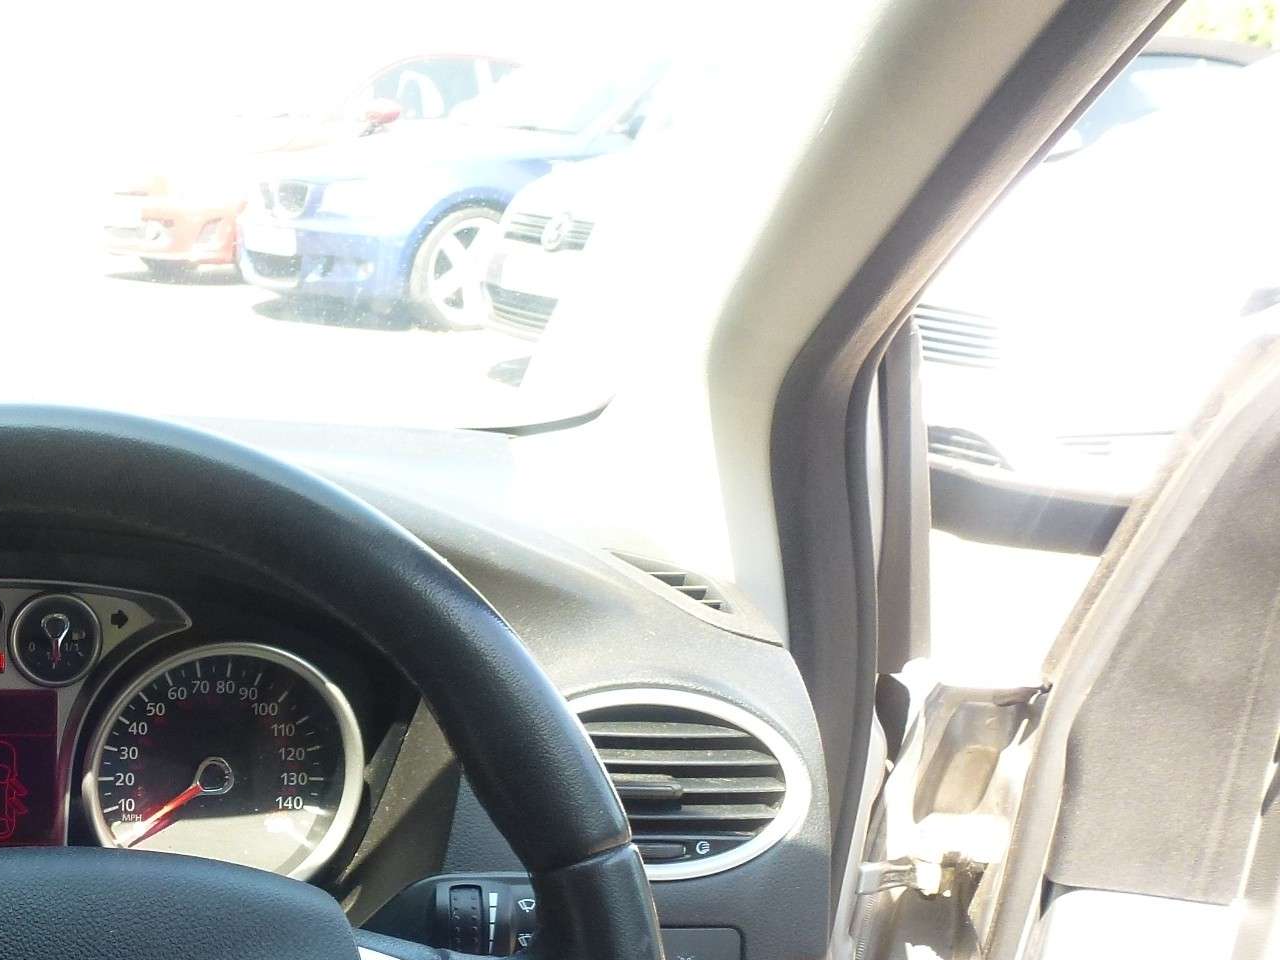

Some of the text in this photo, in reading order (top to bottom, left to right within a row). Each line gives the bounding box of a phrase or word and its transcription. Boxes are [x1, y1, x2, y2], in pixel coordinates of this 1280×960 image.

[167, 687, 187, 700] 60
[191, 680, 210, 694] 70
[215, 680, 235, 694] 80
[239, 687, 258, 700] 90
[146, 702, 166, 716] 50
[251, 702, 279, 716] 100
[128, 722, 148, 735] 40
[271, 723, 296, 737] 110
[119, 746, 139, 760] 30
[278, 747, 305, 761] 120
[115, 772, 135, 786] 20
[280, 772, 308, 786] 130
[117, 798, 135, 812] 10
[275, 796, 304, 810] 140
[121, 813, 143, 822] MPH
